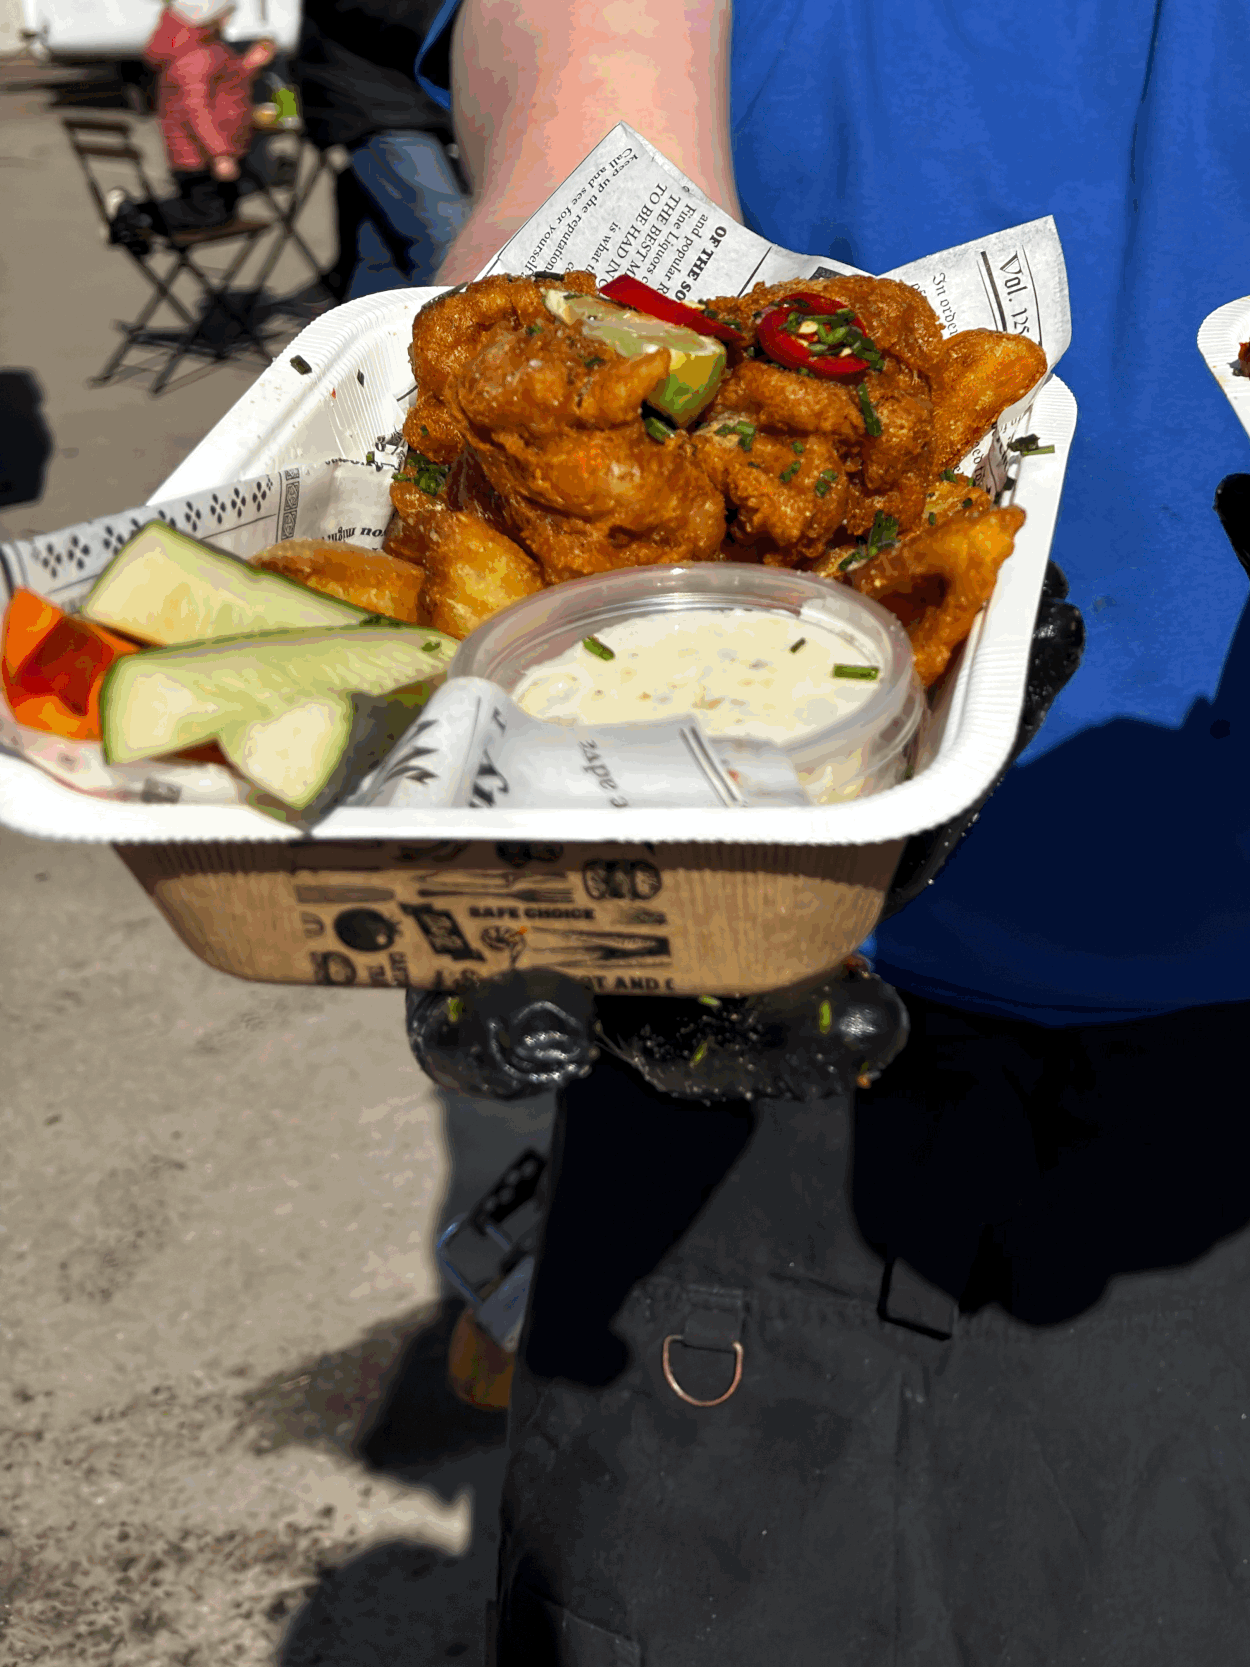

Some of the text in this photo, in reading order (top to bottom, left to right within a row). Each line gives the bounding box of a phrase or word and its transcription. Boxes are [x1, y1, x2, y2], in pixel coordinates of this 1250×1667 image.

[649, 182, 668, 205] TO
[525, 147, 633, 275] Call and see for yourself
[545, 153, 639, 271] keep up the reputation
[635, 203, 653, 227] BE
[656, 194, 682, 226] THE
[673, 203, 697, 231] Fine
[609, 221, 622, 233] is
[616, 224, 642, 259] HAD
[635, 223, 663, 262] BEST
[591, 234, 612, 263] what
[646, 230, 680, 275] Liquors
[665, 214, 709, 282] and popular
[674, 225, 728, 301] OF THE SO
[605, 258, 621, 279] IN
[999, 250, 1028, 303] Vol.
[469, 906, 597, 921] SAFE CHOICE
[614, 975, 660, 990] AND
